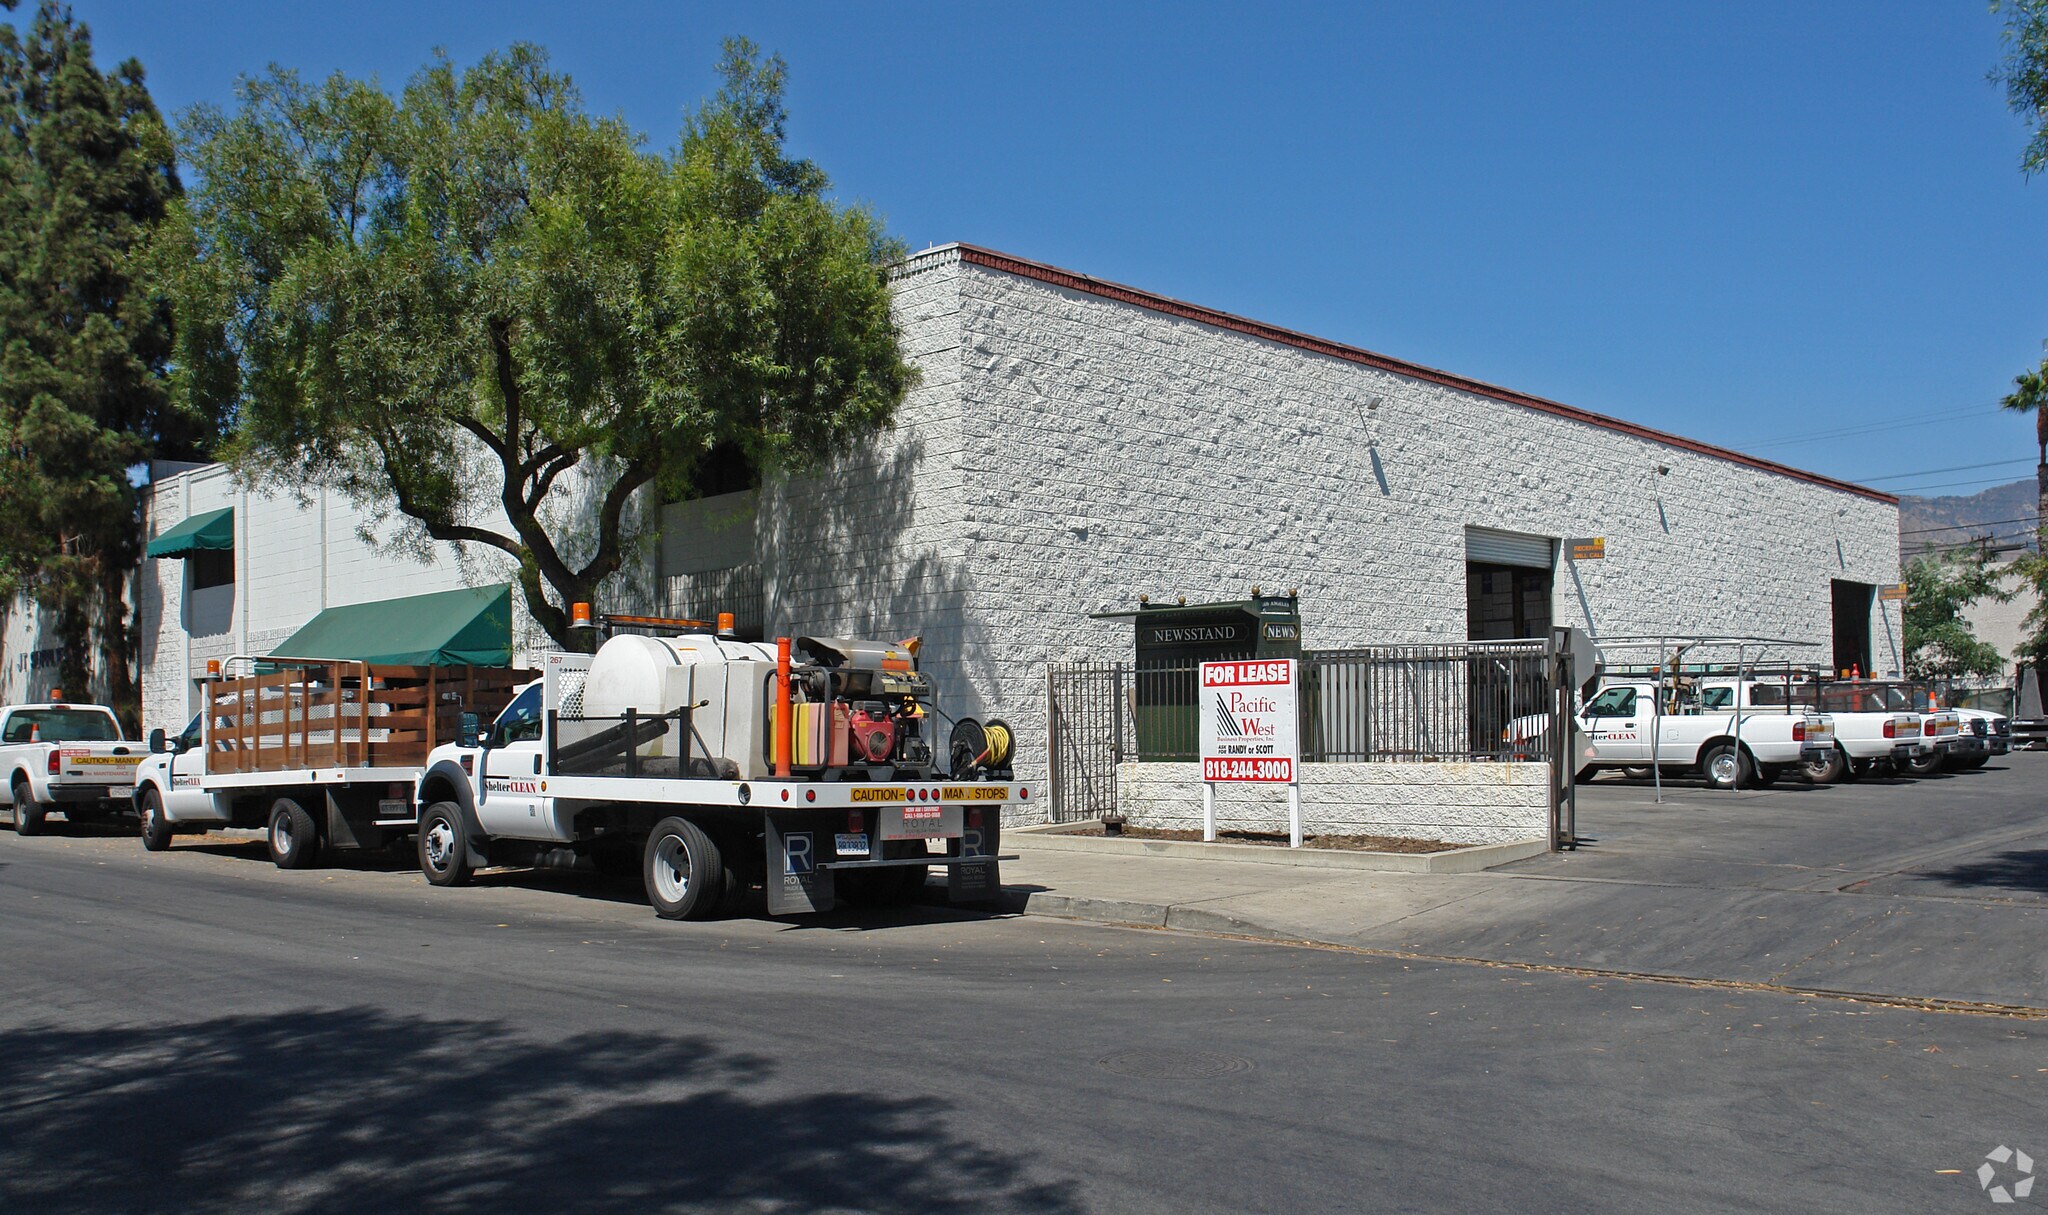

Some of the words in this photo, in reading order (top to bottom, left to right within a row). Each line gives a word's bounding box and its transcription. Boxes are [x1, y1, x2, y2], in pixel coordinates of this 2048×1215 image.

[1154, 626, 1235, 642] NEWSSTAND
[1267, 625, 1295, 638] NEWS
[1205, 666, 1235, 684] FOR
[1238, 663, 1288, 683] LEASE
[1230, 692, 1276, 713] Pacific
[1241, 717, 1275, 736] West
[1587, 733, 1636, 741] elterCLEAN
[1228, 745, 1247, 754] RANDY
[1255, 745, 1274, 754] SCOTT
[1206, 760, 1289, 779] 818-244-3000
[484, 781, 537, 793] ShelterCLEAN
[853, 789, 898, 801] CAUTION
[903, 818, 943, 829] ROYAL
[784, 875, 813, 885] ROYAL
